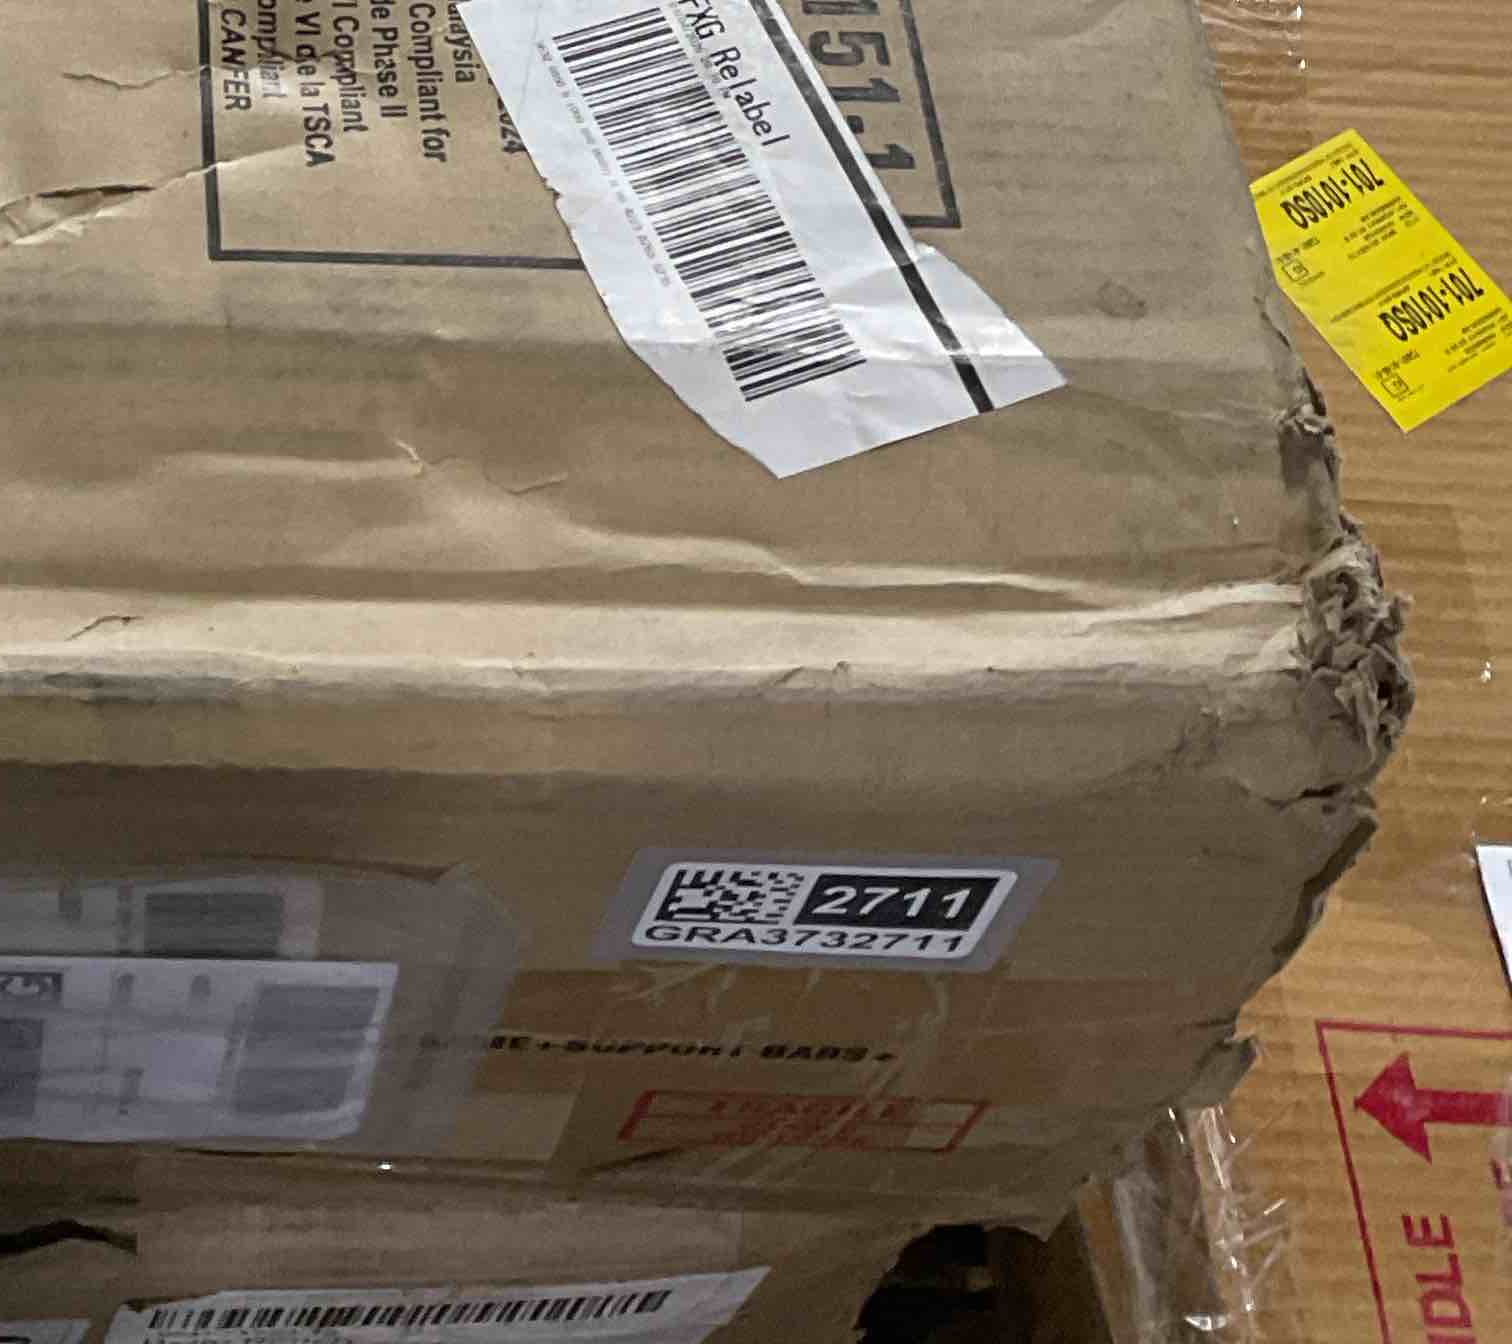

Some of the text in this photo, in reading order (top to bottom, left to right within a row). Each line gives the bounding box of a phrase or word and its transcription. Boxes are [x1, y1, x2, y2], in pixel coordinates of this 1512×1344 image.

[295, 12, 320, 36] VI
[219, 9, 252, 111] CANFER
[296, 40, 321, 77] de
[300, 81, 326, 98] la
[331, 15, 368, 132] Compliant
[371, 27, 401, 98] Phase
[408, 3, 443, 121] Compliant
[379, 104, 408, 118] II
[710, 46, 790, 146] Relabel
[302, 103, 335, 167] TSCA
[421, 124, 450, 162] for
[1280, 158, 1385, 229] 701-1010SQ
[1378, 267, 1485, 342] 701-1010SQ
[810, 885, 972, 919] 2711
[644, 924, 968, 954] GRA3732711
[1402, 1214, 1477, 1344] DLE
